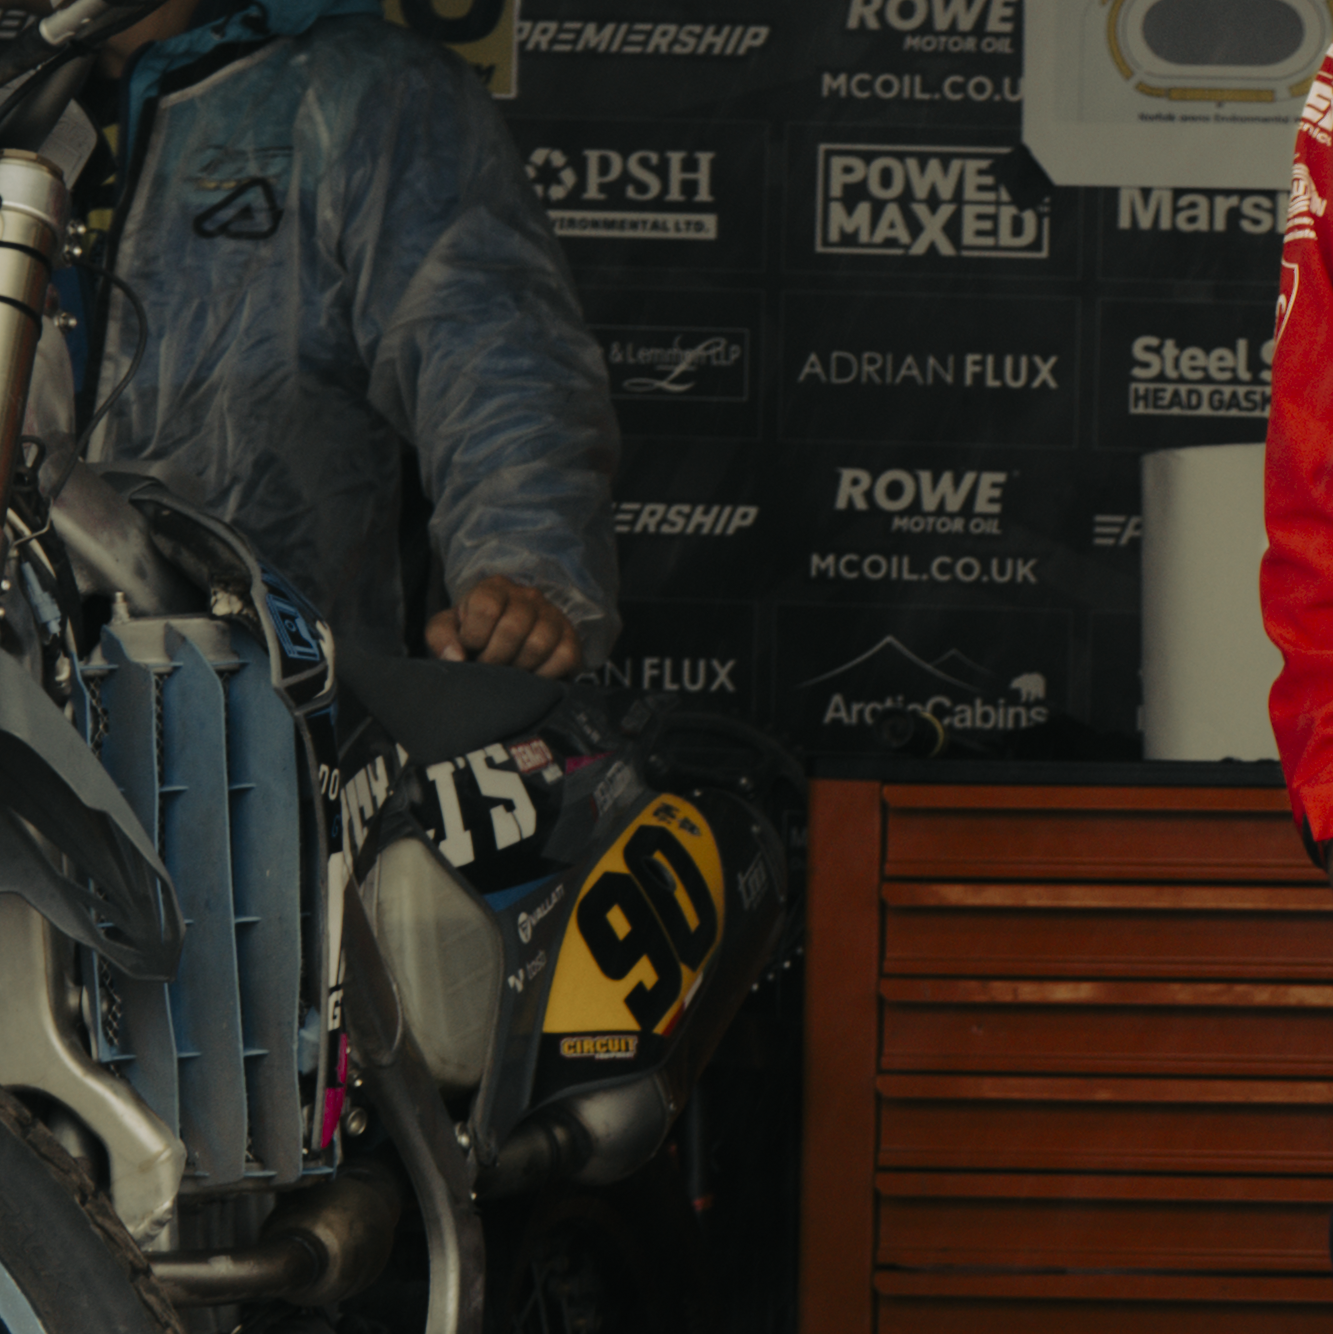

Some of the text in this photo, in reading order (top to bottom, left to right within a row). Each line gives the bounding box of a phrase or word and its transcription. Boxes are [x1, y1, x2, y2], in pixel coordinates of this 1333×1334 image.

[903, 35, 1014, 55] MOTOR OIL
[581, 149, 716, 202] PSH
[826, 201, 1040, 258] MAXED
[797, 351, 1059, 389] ADRIAN FLUX
[1130, 335, 1250, 383] Steel
[1132, 387, 1201, 411] HEAD
[834, 469, 1008, 514] ROWE
[892, 515, 1002, 536] MOTOR OIL
[809, 553, 1039, 585] MCOIL.CO.UK
[641, 657, 737, 693] FLUX
[576, 823, 720, 1033] 90
[560, 1034, 638, 1058] CIRCUIT
